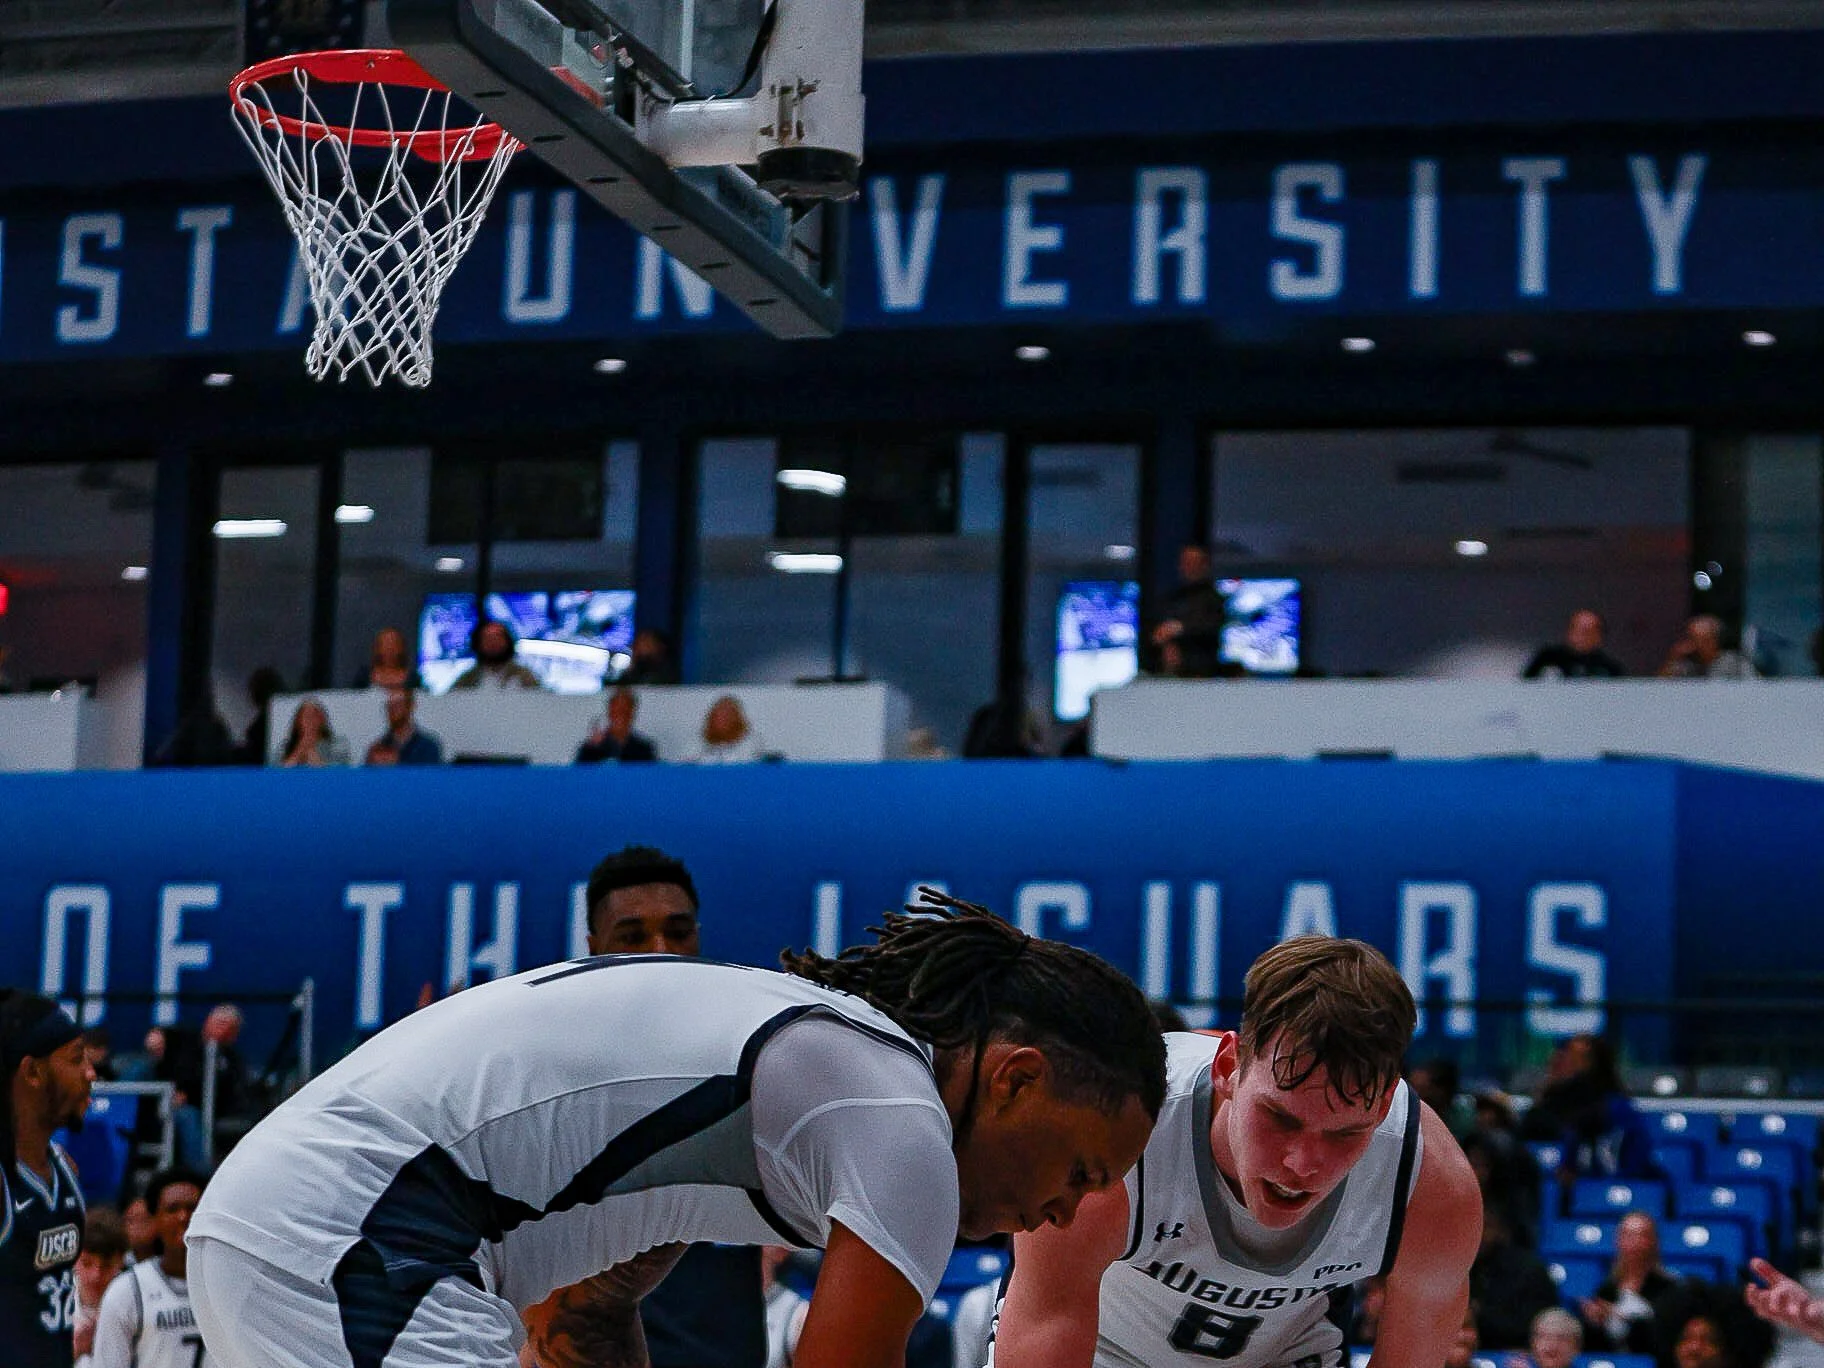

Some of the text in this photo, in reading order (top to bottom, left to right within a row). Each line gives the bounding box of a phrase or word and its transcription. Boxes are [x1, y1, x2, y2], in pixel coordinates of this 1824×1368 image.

[500, 153, 1707, 324] UVERSITY
[40, 884, 222, 1028] OF
[1166, 1301, 1264, 1360] 8
